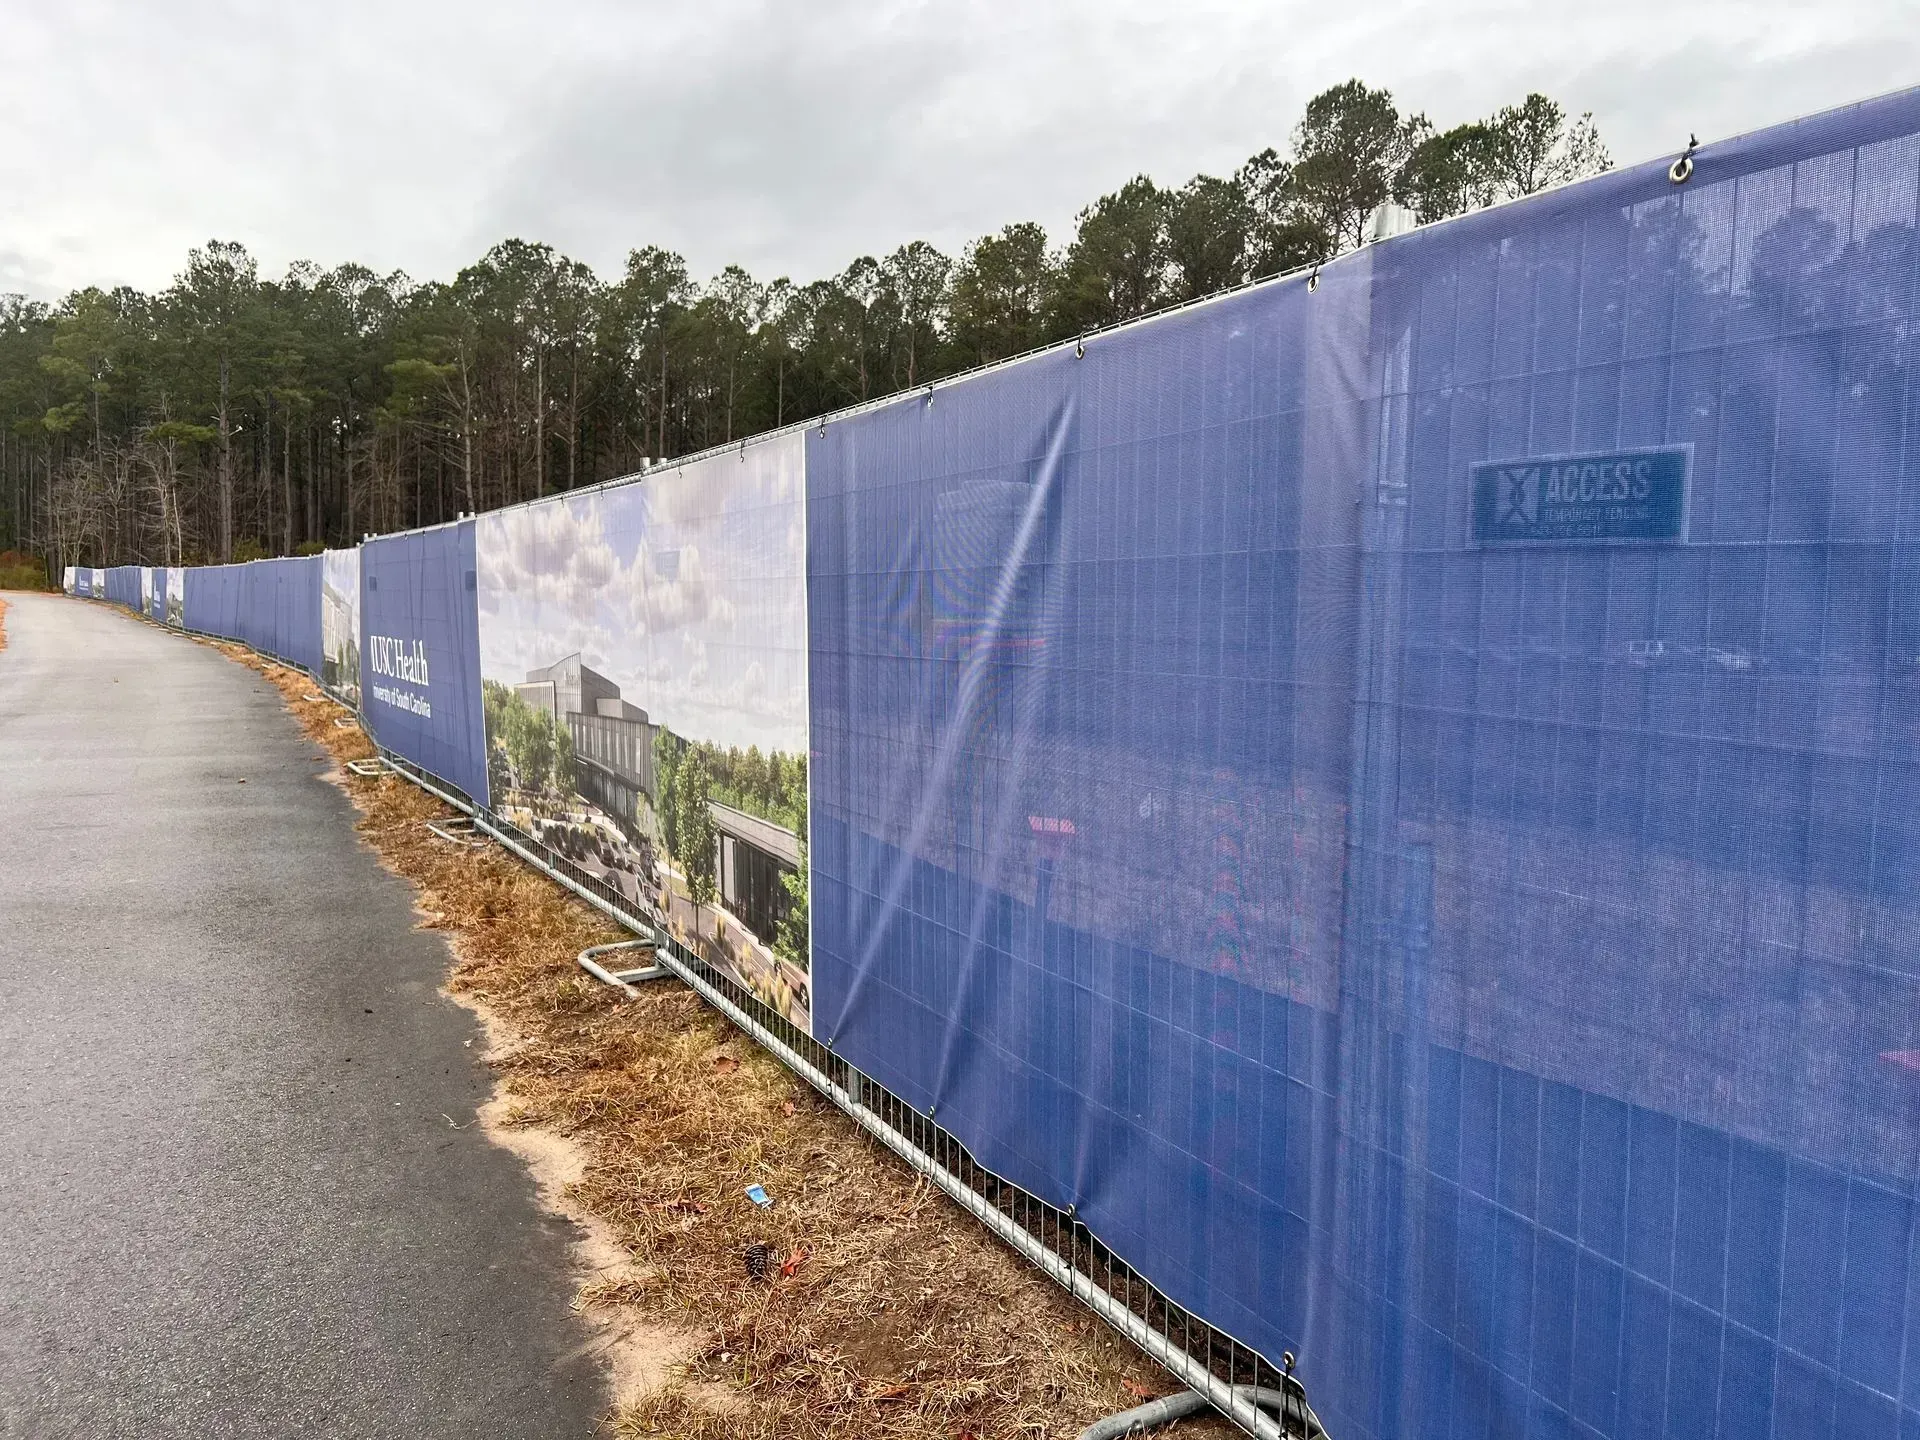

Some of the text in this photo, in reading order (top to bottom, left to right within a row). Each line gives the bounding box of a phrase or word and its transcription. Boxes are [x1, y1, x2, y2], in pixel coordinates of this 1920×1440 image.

[1545, 460, 1652, 503] ACCESS
[394, 639, 429, 686] Health
[373, 681, 391, 707] niversity
[396, 688, 410, 710] South
[410, 692, 431, 718] Carolina
